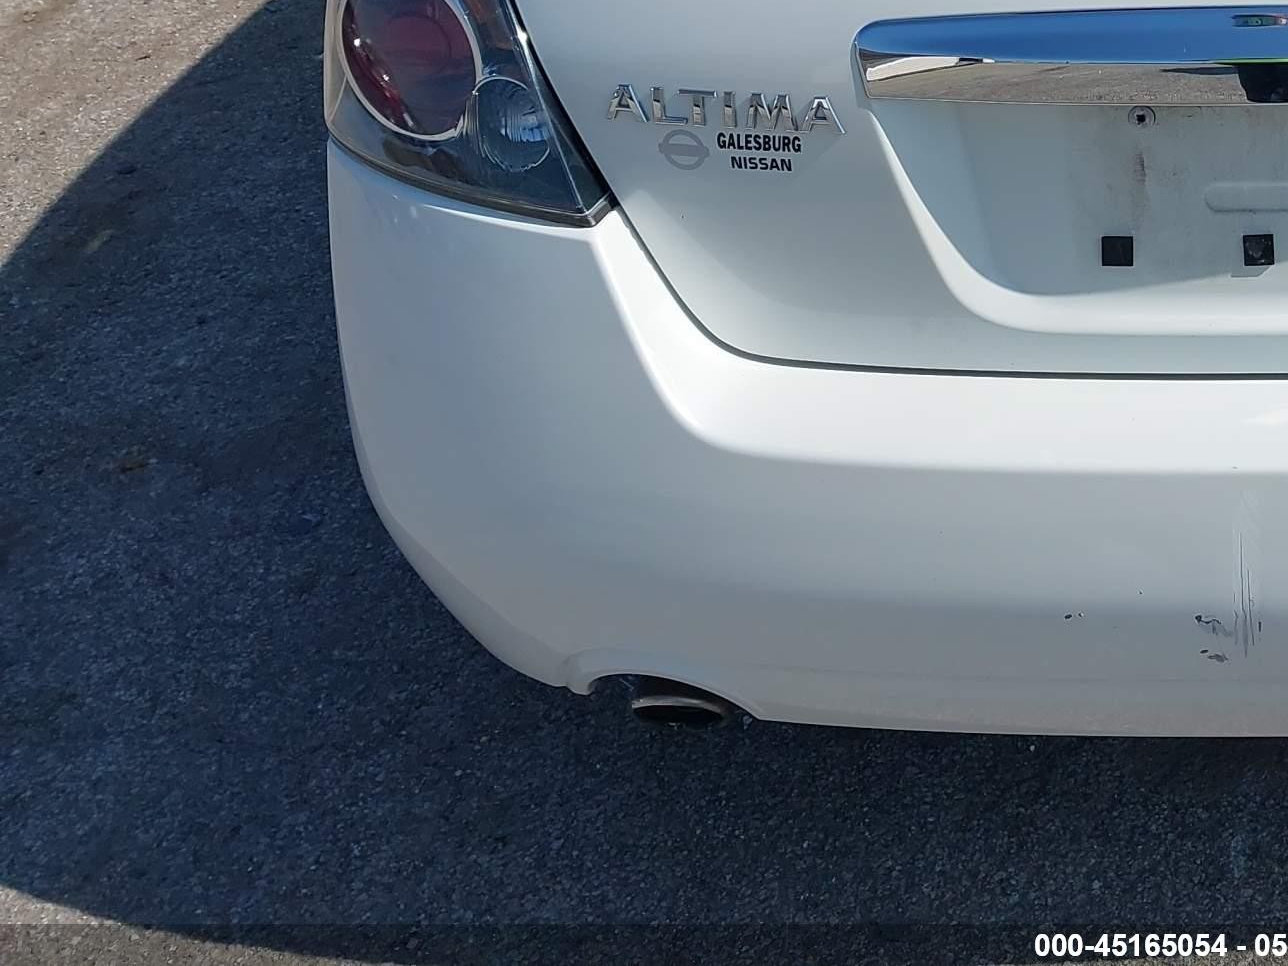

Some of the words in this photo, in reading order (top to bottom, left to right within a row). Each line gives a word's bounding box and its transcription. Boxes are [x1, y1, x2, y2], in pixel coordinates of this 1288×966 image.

[606, 84, 847, 135] ALTIMA
[716, 132, 802, 154] GALESBURG
[730, 156, 793, 172] NISSAN
